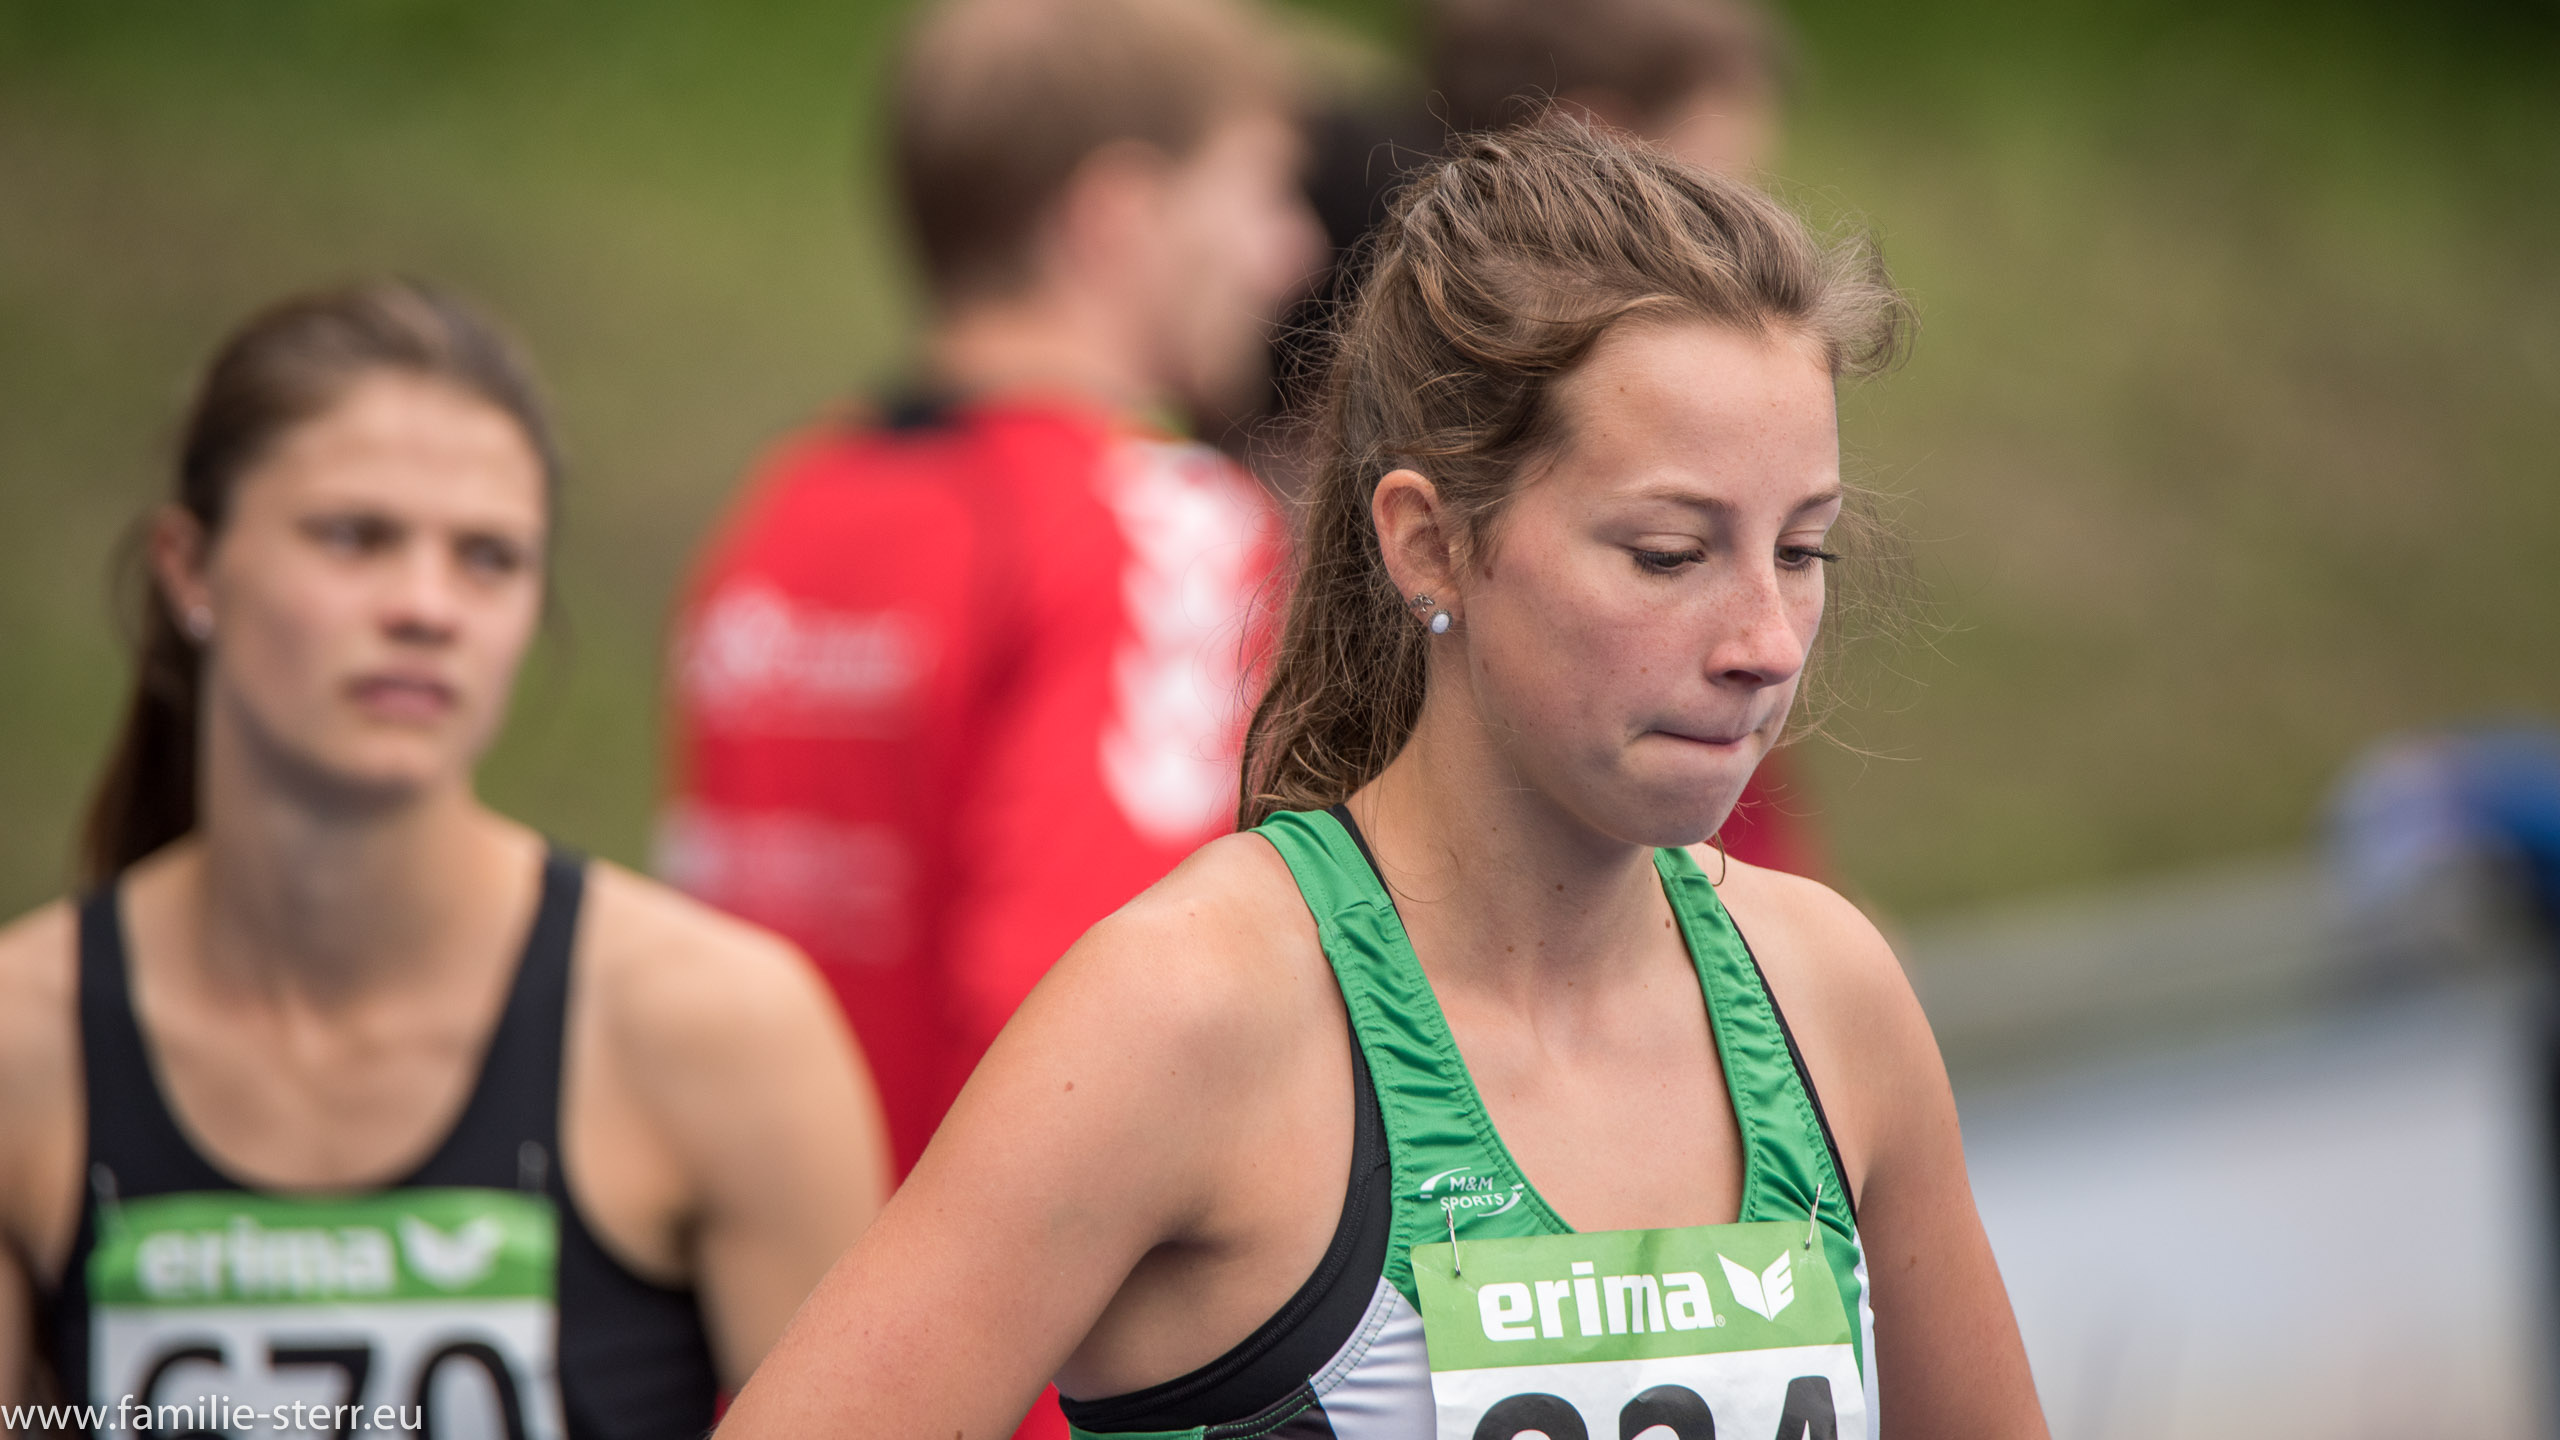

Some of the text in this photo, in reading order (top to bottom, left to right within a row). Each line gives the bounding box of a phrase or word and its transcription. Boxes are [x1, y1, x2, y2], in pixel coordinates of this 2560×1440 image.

[1440, 1192, 1505, 1212] SPORTS
[1449, 1176, 1493, 1192] M&M
[137, 1215, 395, 1297] erima
[1477, 1260, 1716, 1343] erima
